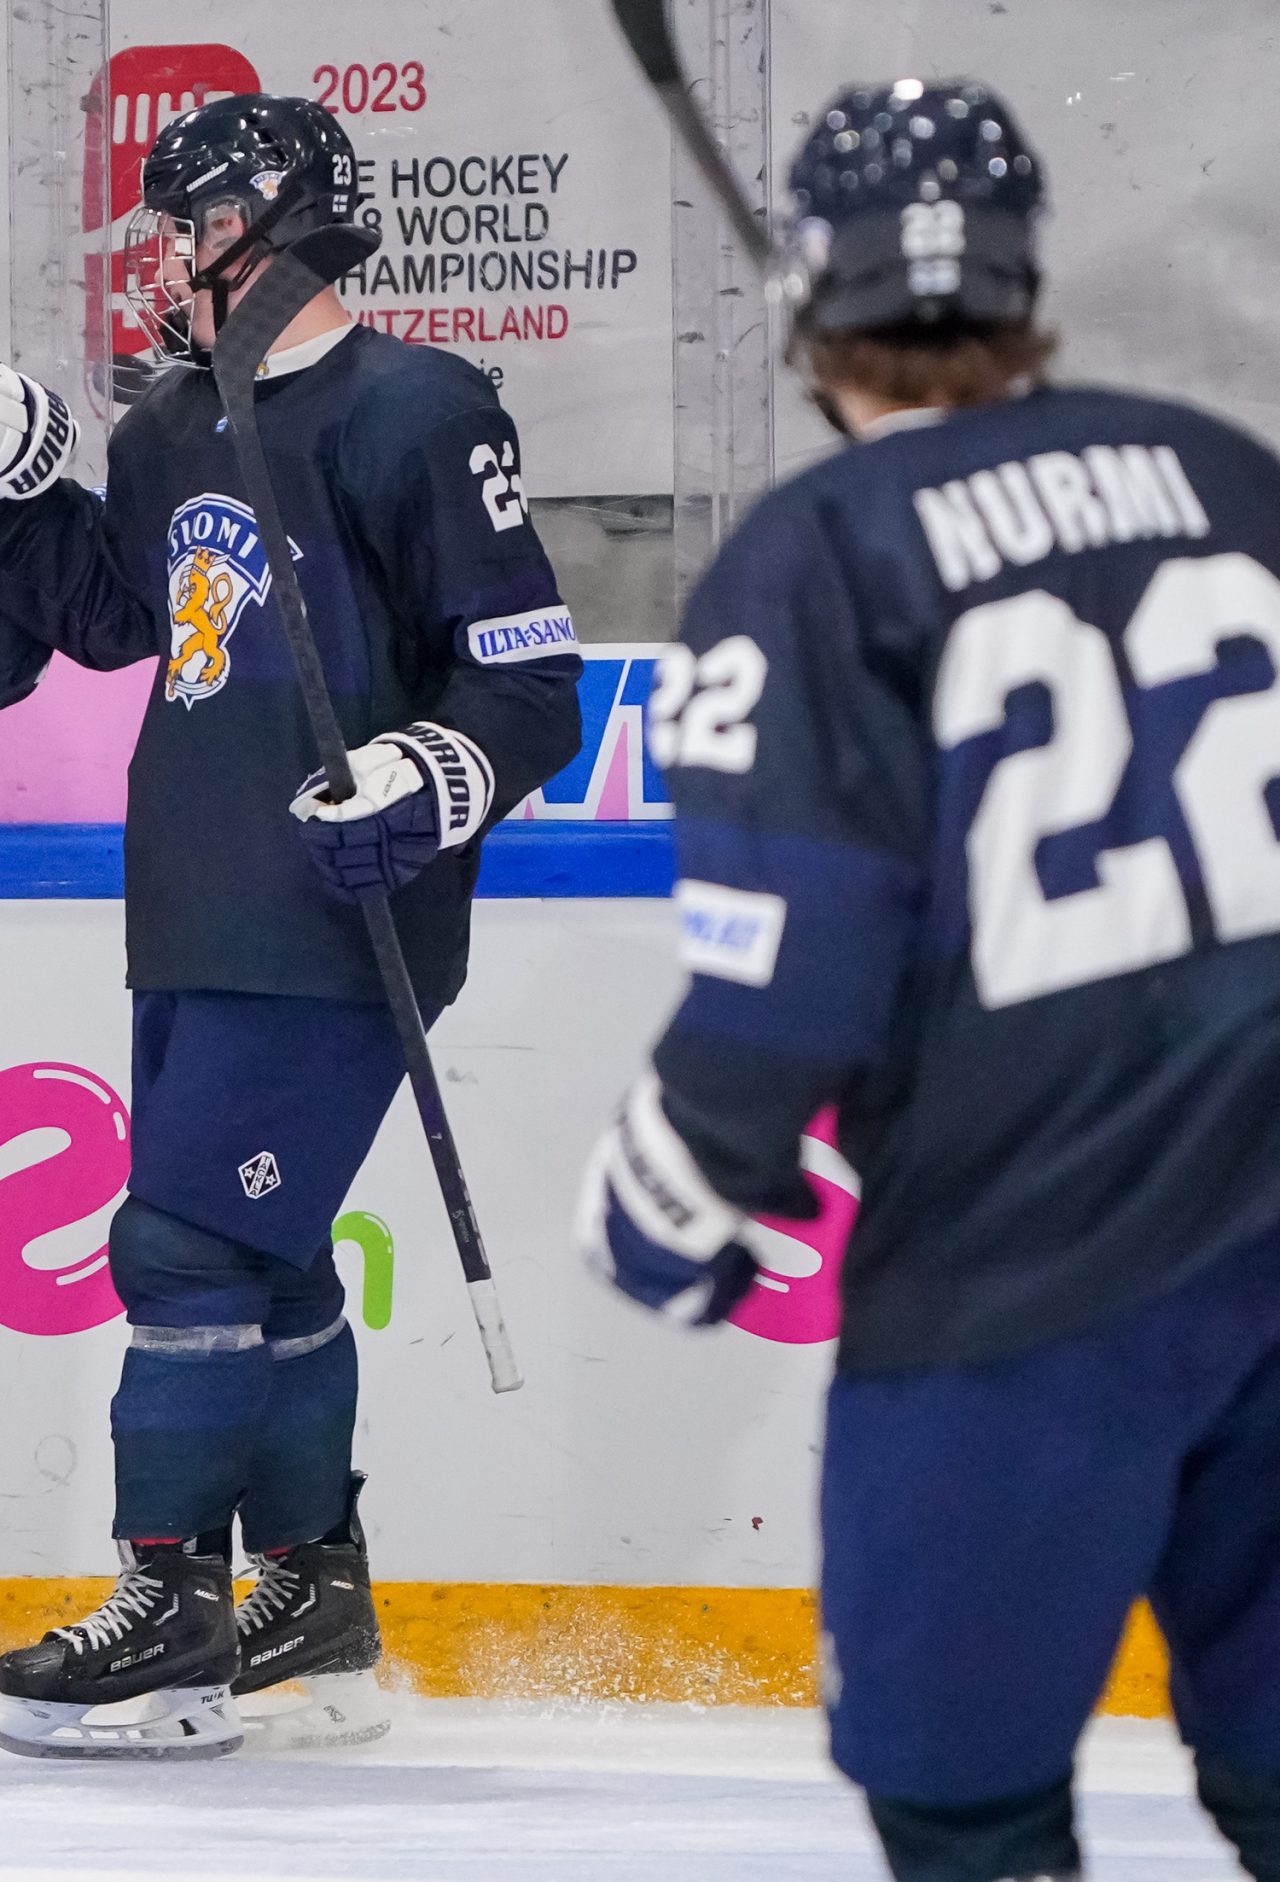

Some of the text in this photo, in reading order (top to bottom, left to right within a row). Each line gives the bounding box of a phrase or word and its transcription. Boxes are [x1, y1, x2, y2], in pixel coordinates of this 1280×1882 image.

[312, 60, 428, 115] 2023
[112, 90, 234, 145] IIH
[331, 153, 353, 186] 23
[391, 153, 570, 199] HOCKEY
[398, 202, 551, 247] WORLD
[339, 248, 638, 296] HAMPIONSHIP
[913, 444, 1212, 592] NURMI
[932, 551, 1280, 1012] 22
[110, 1642, 165, 1673] BAUER
[250, 1635, 305, 1667] BAUER
